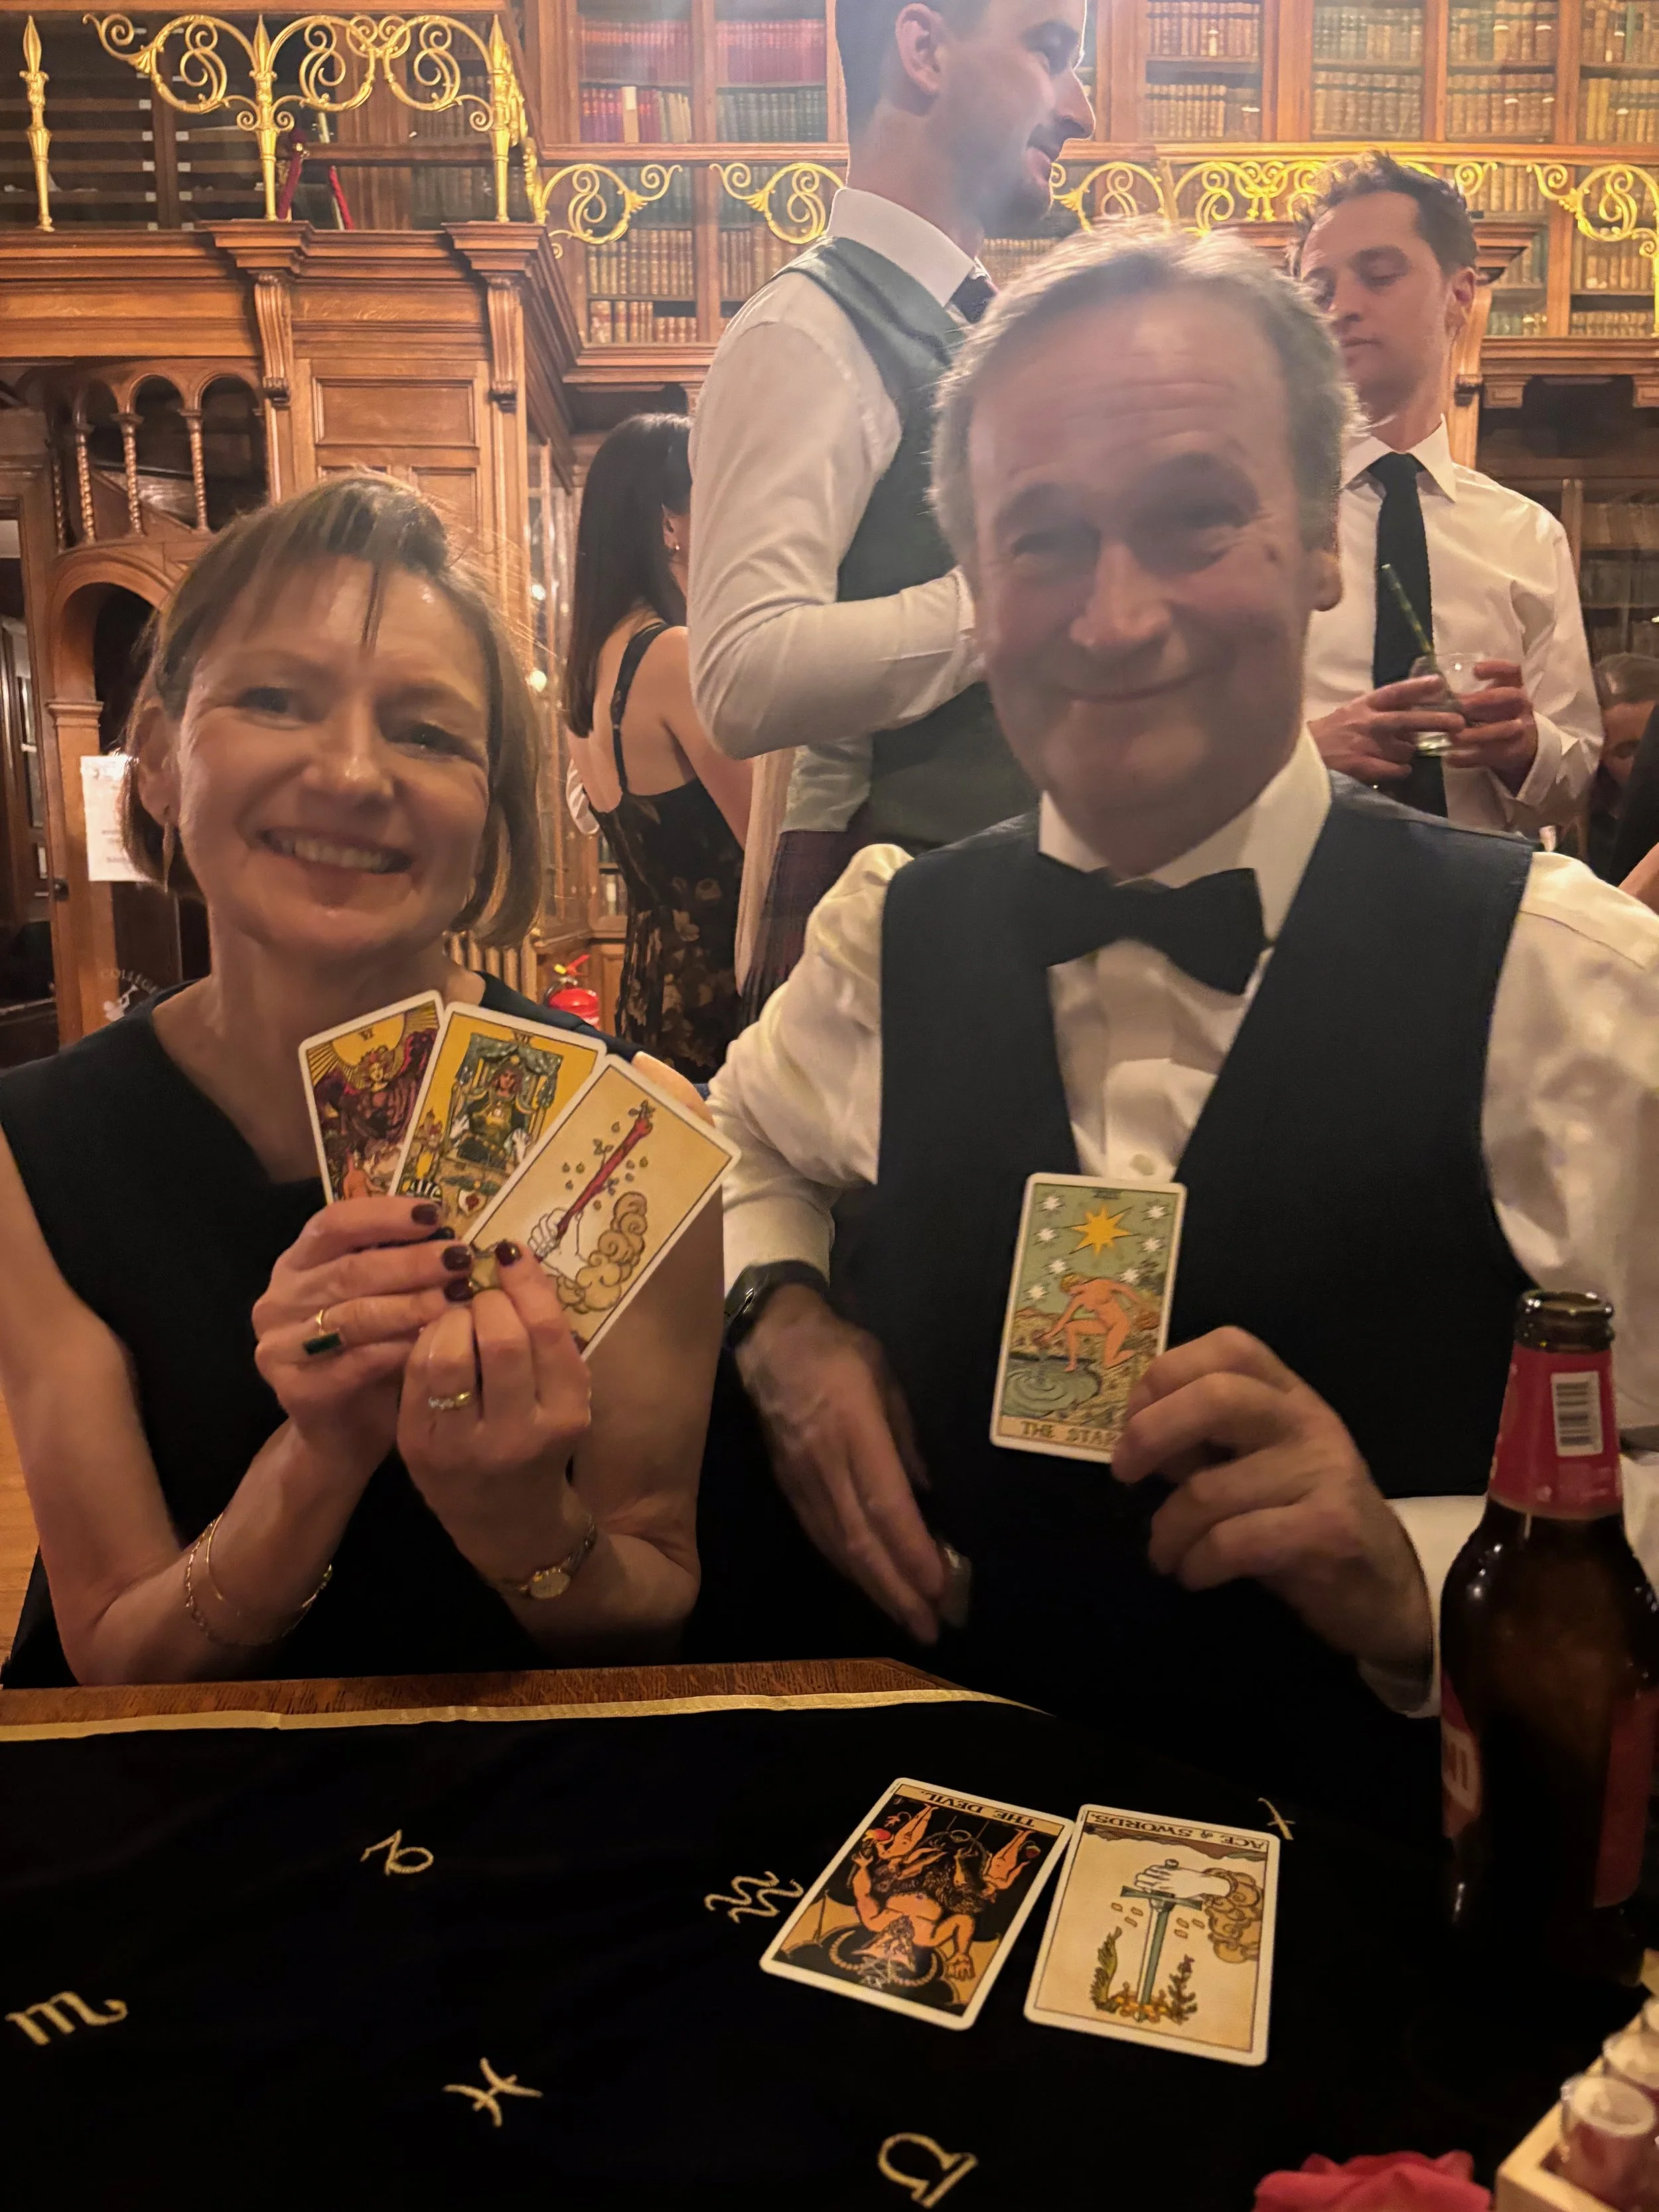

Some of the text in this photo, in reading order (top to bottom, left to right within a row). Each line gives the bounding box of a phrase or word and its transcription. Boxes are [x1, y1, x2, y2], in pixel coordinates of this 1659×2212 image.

[1021, 1420, 1056, 1438] THE
[994, 1810, 1035, 1827] THE
[1091, 1813, 1193, 1837] SWORDS.
[1220, 1835, 1263, 1850] ACE
